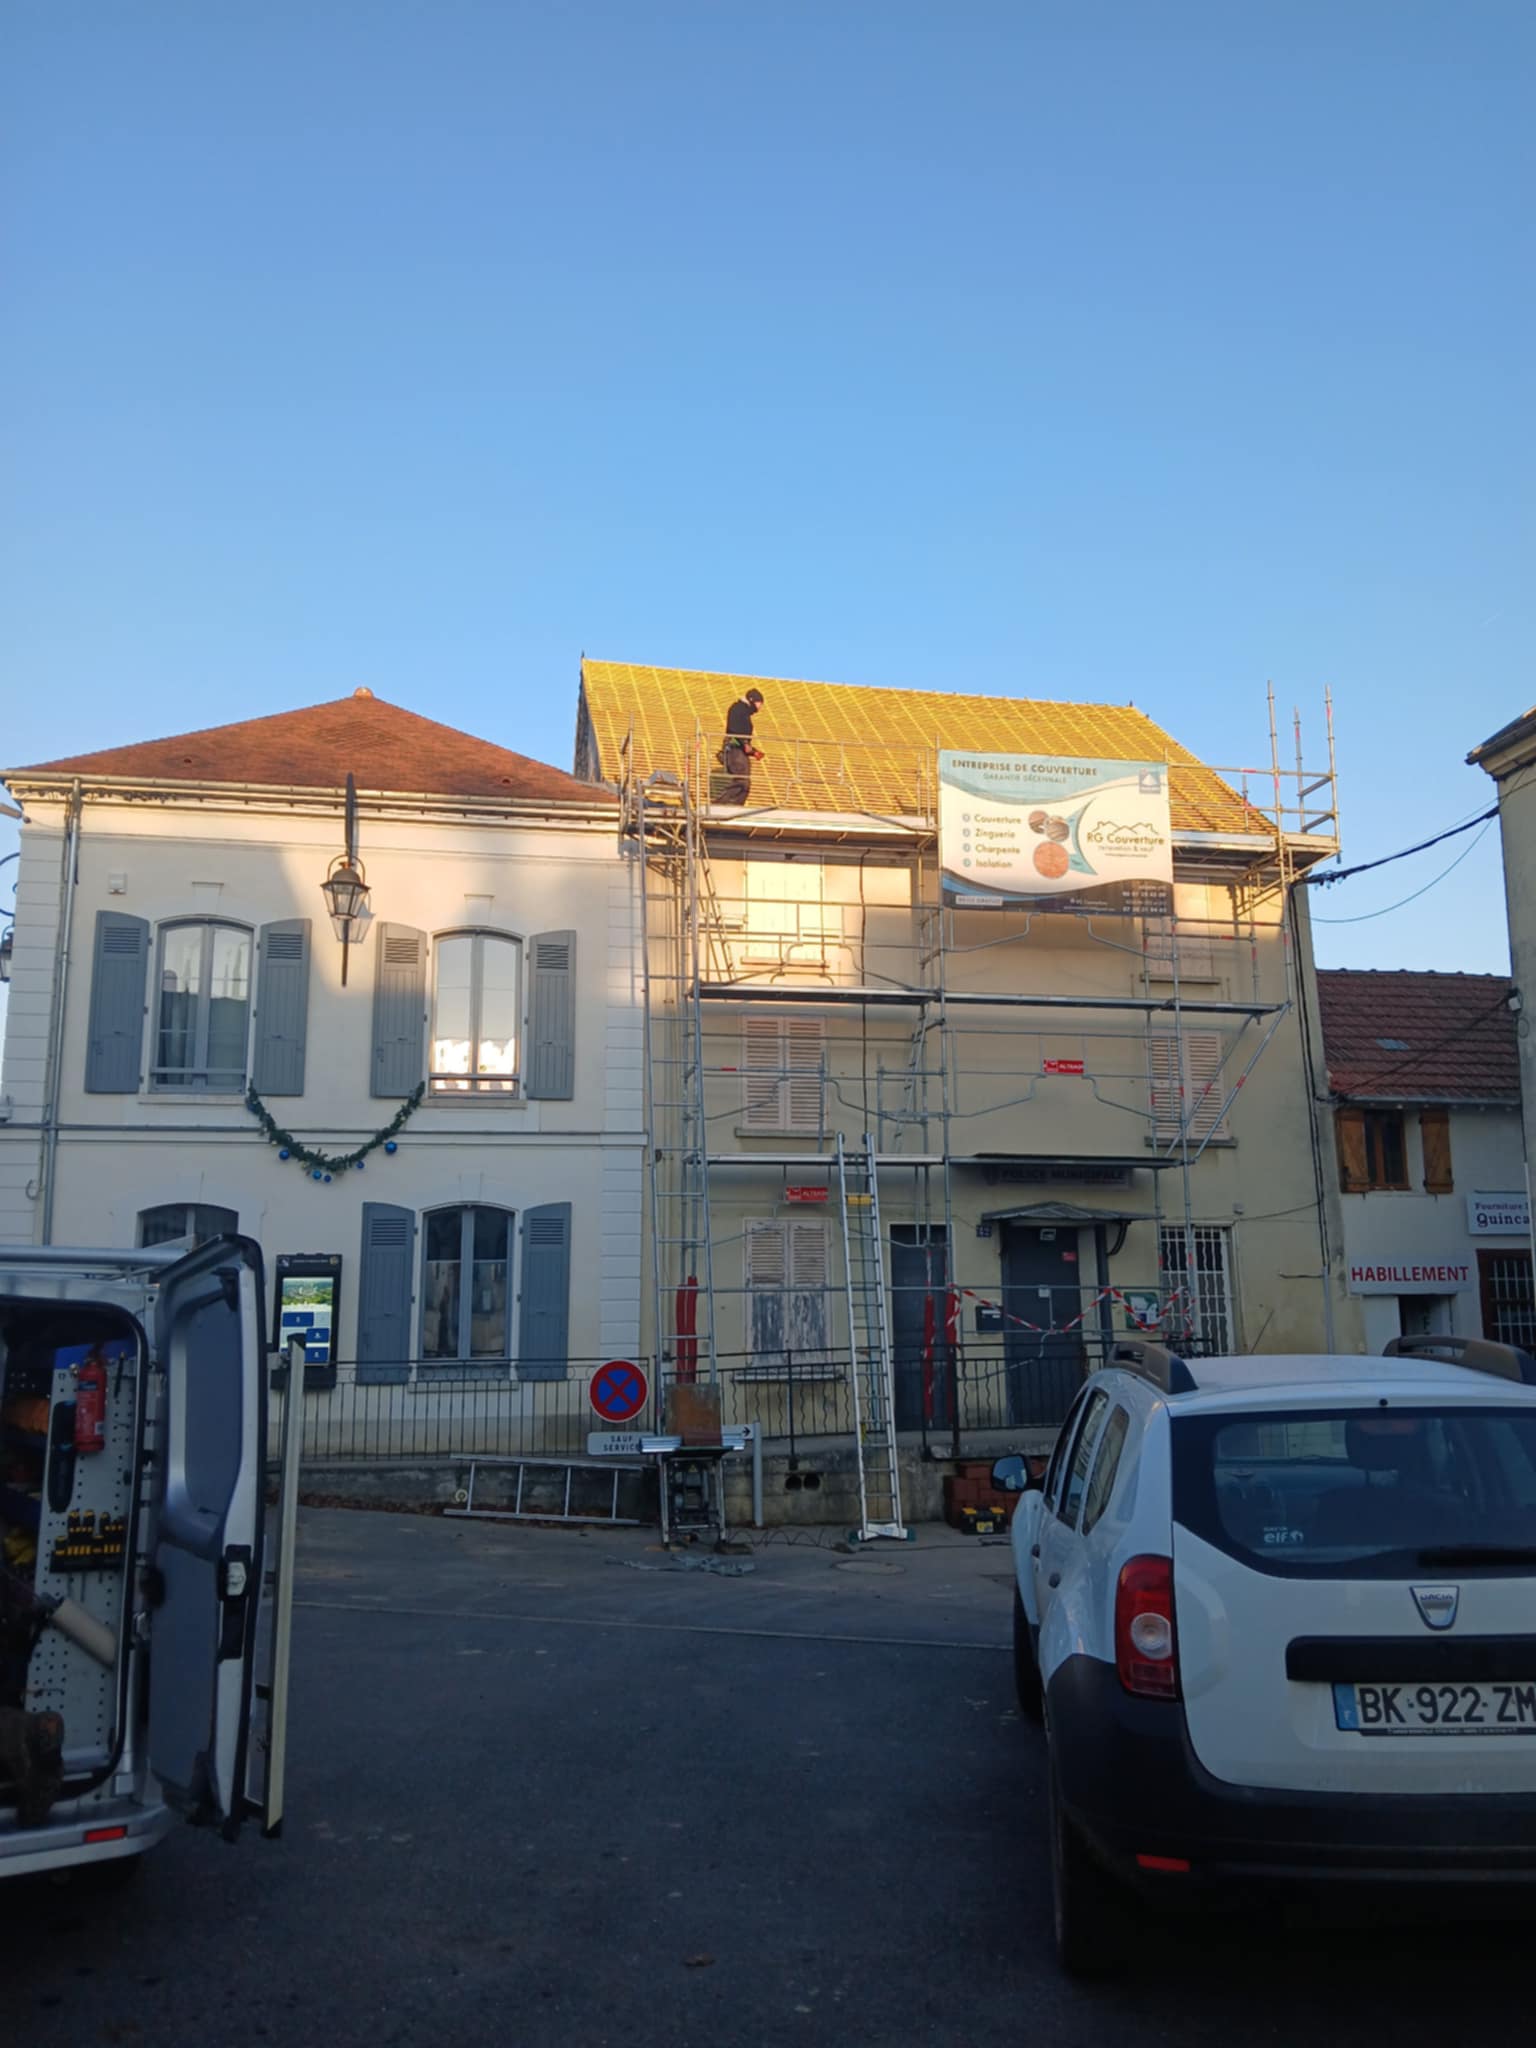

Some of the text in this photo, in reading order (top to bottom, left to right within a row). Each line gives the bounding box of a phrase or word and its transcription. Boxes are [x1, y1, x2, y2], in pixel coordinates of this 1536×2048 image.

[951, 759, 1098, 777] ENTREPRISE DE COUVERTURE
[974, 814, 1022, 825] Couverture
[1086, 832, 1165, 846] RG Couverture
[975, 844, 1021, 856] Charpente
[1351, 1266, 1469, 1282] HABILLEMENT
[1264, 1531, 1288, 1543] elf
